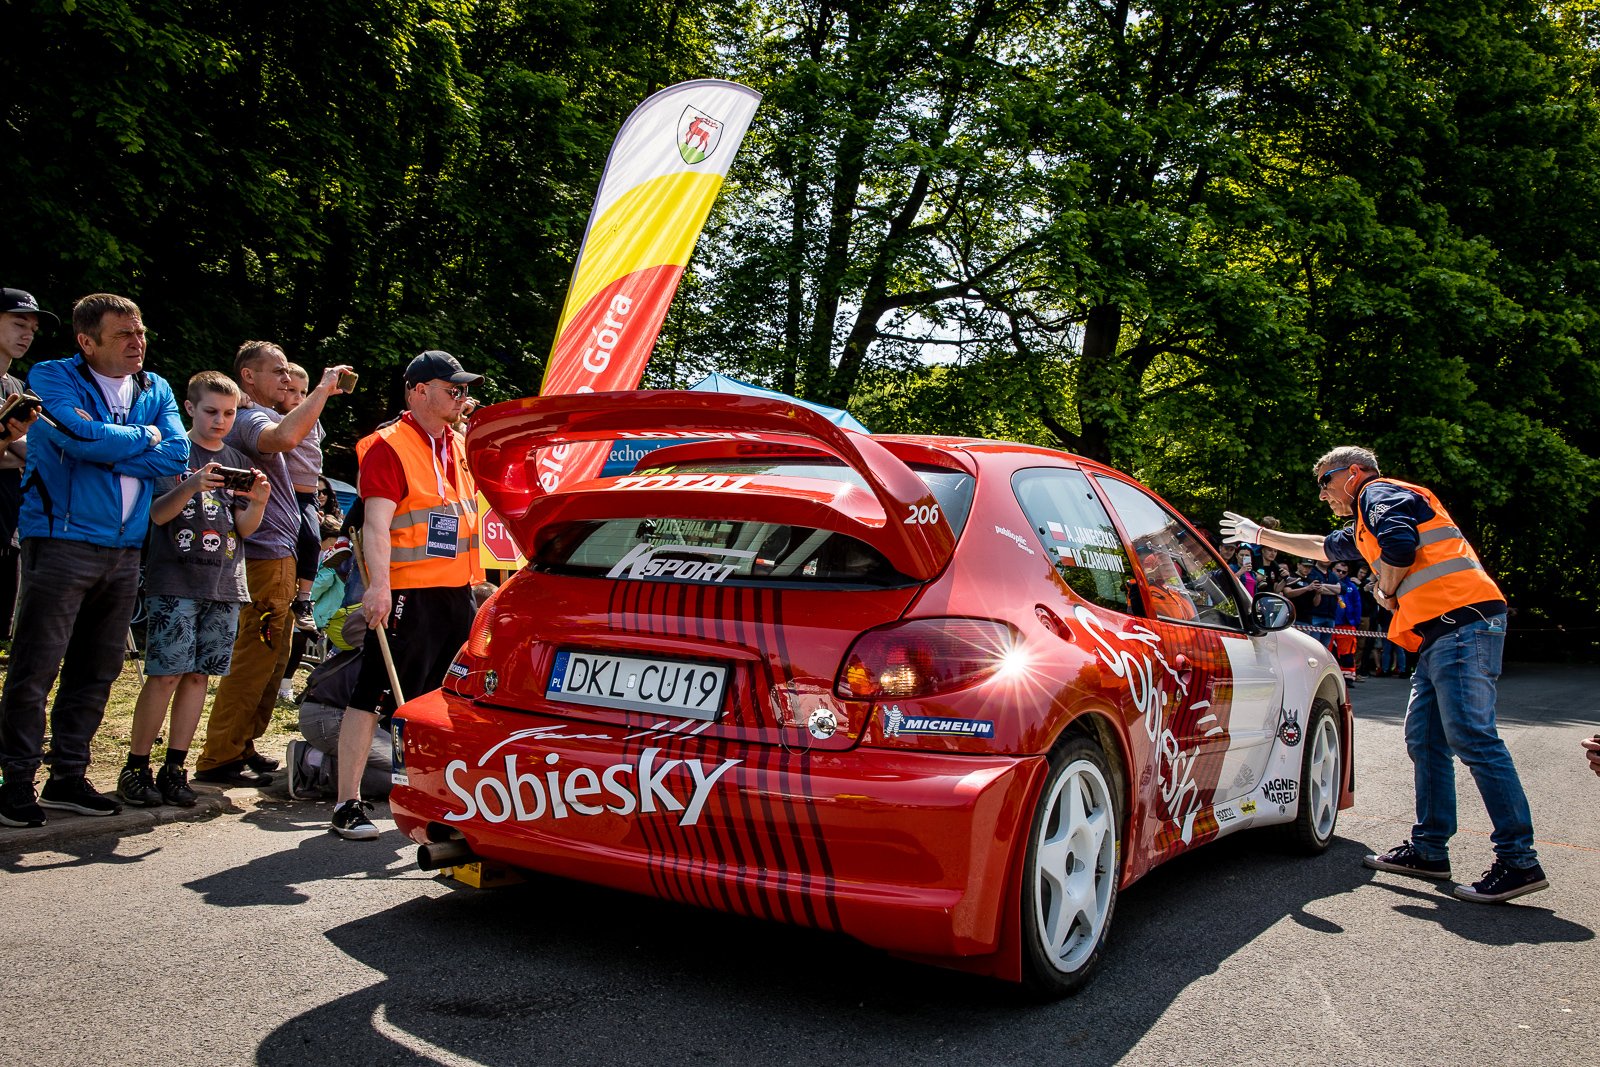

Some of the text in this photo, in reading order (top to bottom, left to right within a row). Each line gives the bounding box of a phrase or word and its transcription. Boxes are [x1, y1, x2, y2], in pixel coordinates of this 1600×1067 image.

[582, 293, 633, 374] Góra
[607, 475, 755, 493] TOTAL
[903, 503, 939, 525] 206
[394, 594, 405, 620] EASY
[551, 677, 562, 688] PL
[566, 657, 718, 707] DKL CU19
[904, 719, 992, 733] MICHELIN
[1261, 778, 1299, 797] MAGNET
